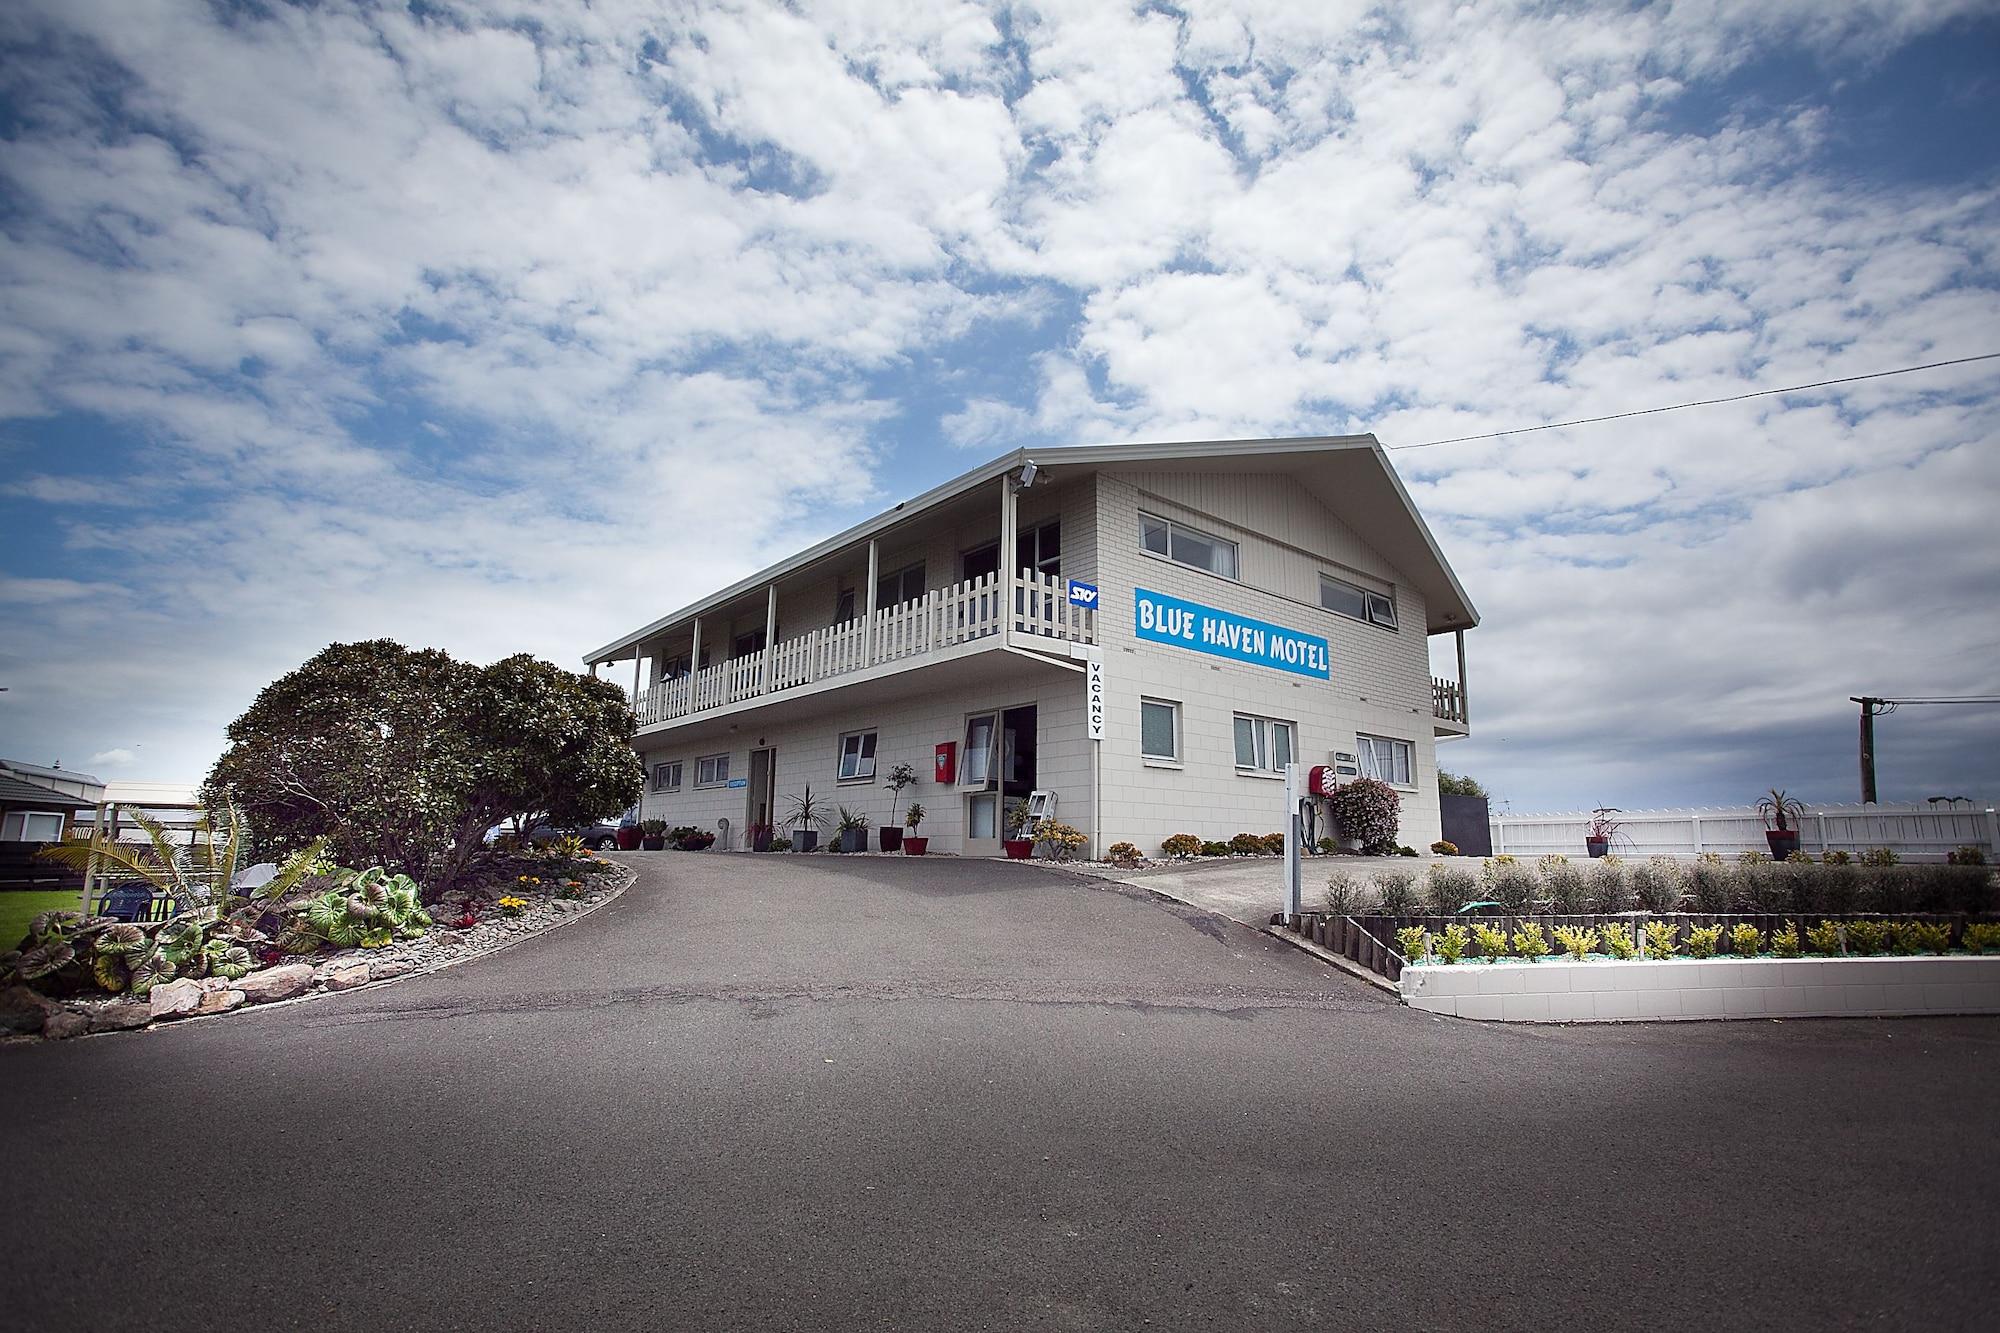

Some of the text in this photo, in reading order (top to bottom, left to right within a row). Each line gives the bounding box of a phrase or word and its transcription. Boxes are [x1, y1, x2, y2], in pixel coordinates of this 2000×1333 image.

[1138, 599, 1328, 671] BLUE HAVEN MOTEL
[1091, 663, 1102, 734] VACANCY
